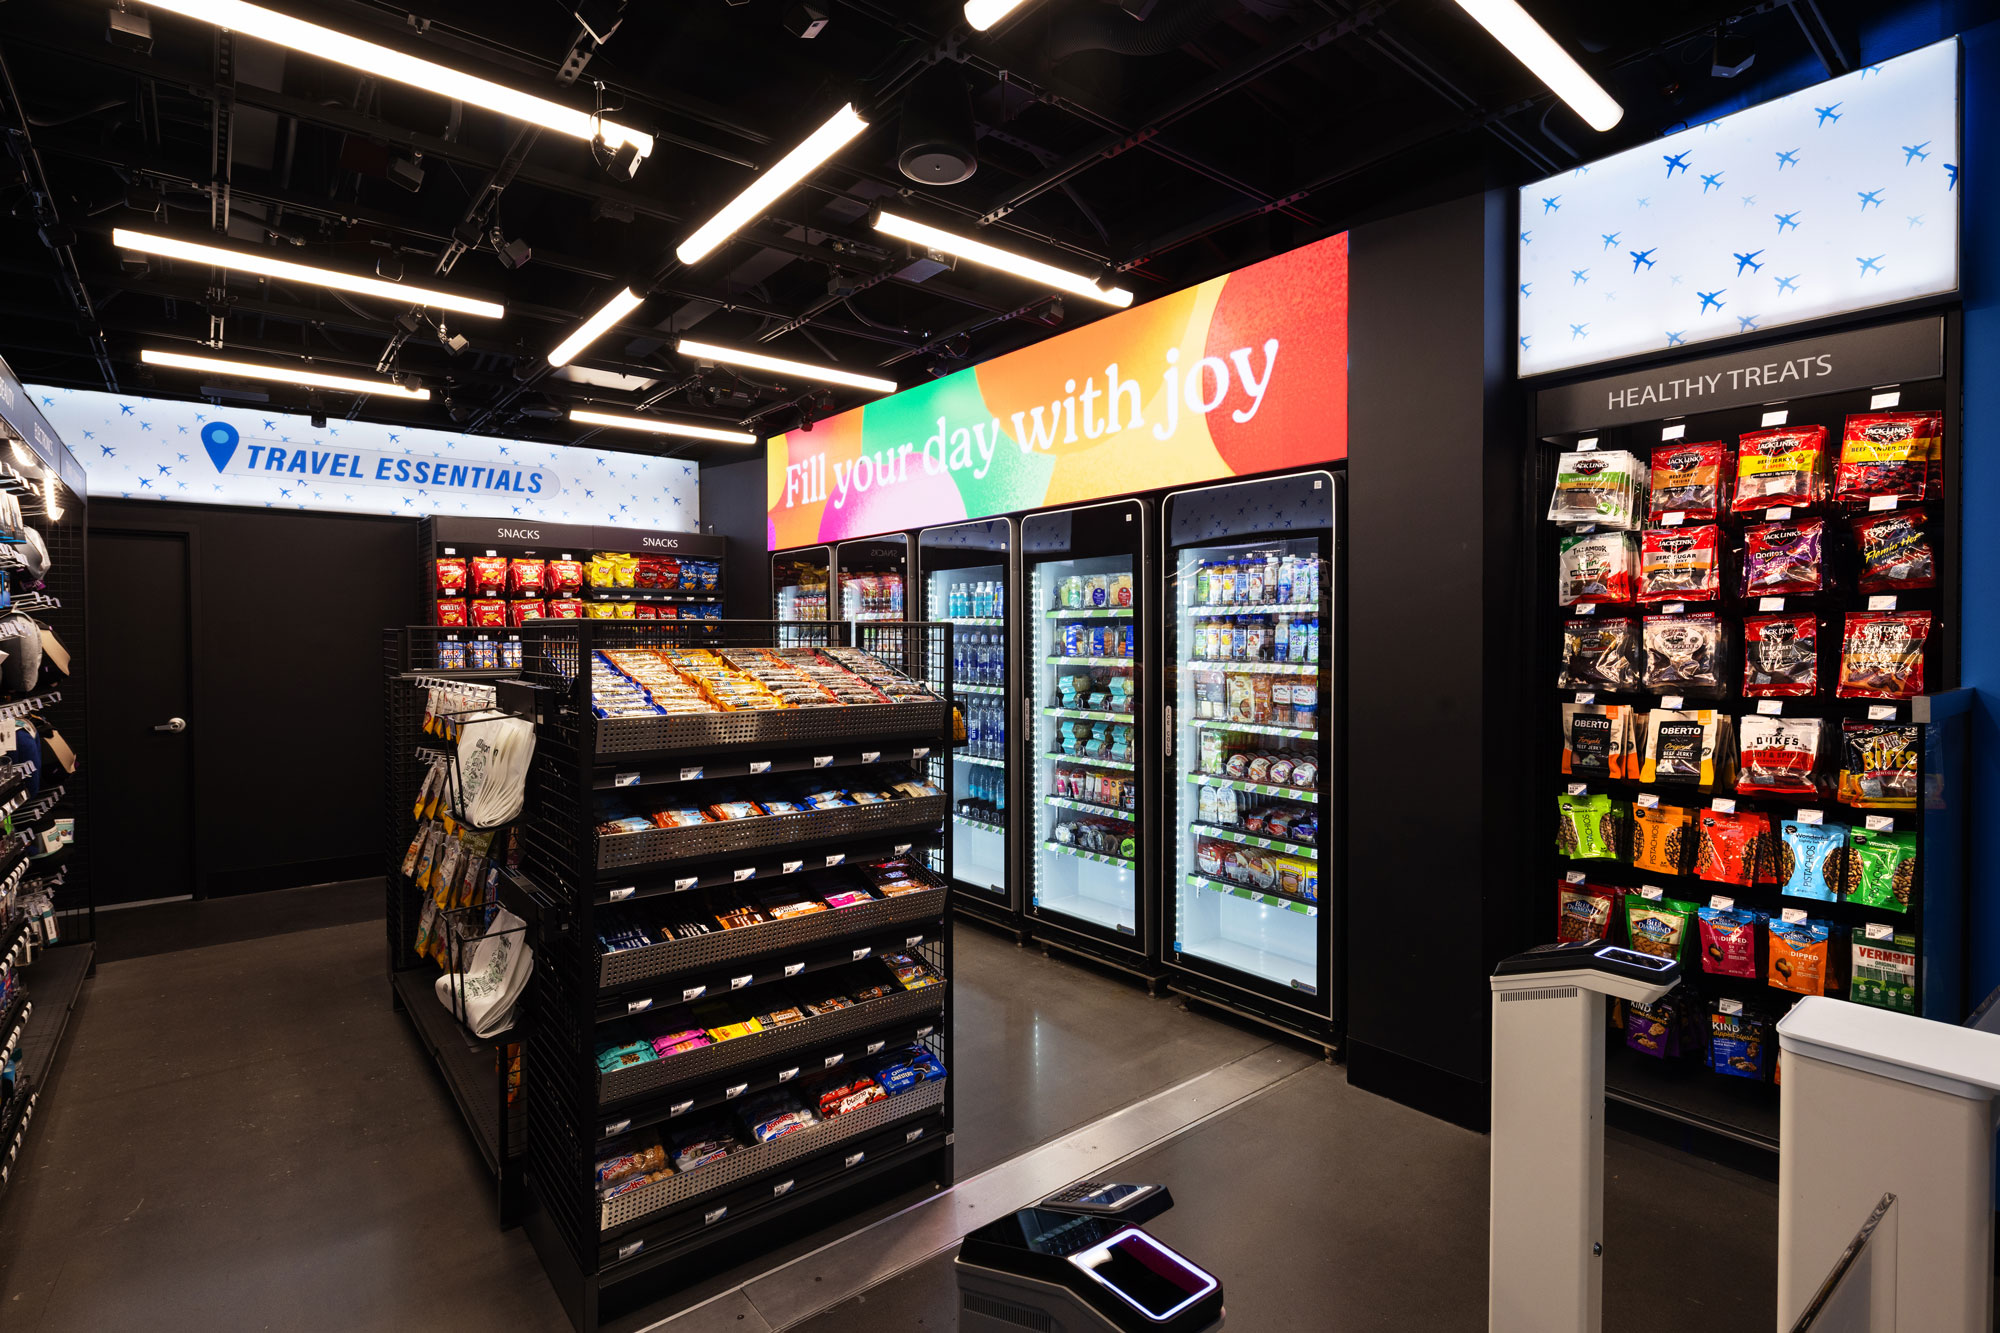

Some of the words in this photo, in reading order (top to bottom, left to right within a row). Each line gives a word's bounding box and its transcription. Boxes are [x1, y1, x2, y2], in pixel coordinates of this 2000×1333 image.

[1608, 372, 1722, 410] HEALTHY
[1726, 354, 1833, 390] TREATS
[785, 451, 827, 509] Fill
[834, 442, 914, 510] your
[922, 416, 1000, 481] day
[1011, 362, 1143, 455] with
[1152, 338, 1279, 442] joy
[247, 444, 365, 480] TRAVEL
[375, 457, 545, 495] ESSENTIALS
[497, 527, 540, 540] SNACKS
[1762, 533, 1780, 541] JACK
[642, 537, 679, 549] SNACKS
[1756, 550, 1784, 558] Doritos
[1574, 720, 1610, 729] OBERTO
[1862, 750, 1918, 771] BITES
[1650, 824, 1660, 865] PISTACHIOS
[1803, 844, 1816, 888] PISTACHIOS
[1638, 922, 1672, 934] DIAMOND
[1646, 918, 1662, 928] BLUE
[1858, 946, 1916, 966] VERMONT
[1712, 1022, 1740, 1032] KIND
[846, 1090, 867, 1106] bueno
[766, 1112, 794, 1132] donettes
[602, 1156, 636, 1180] donettes
